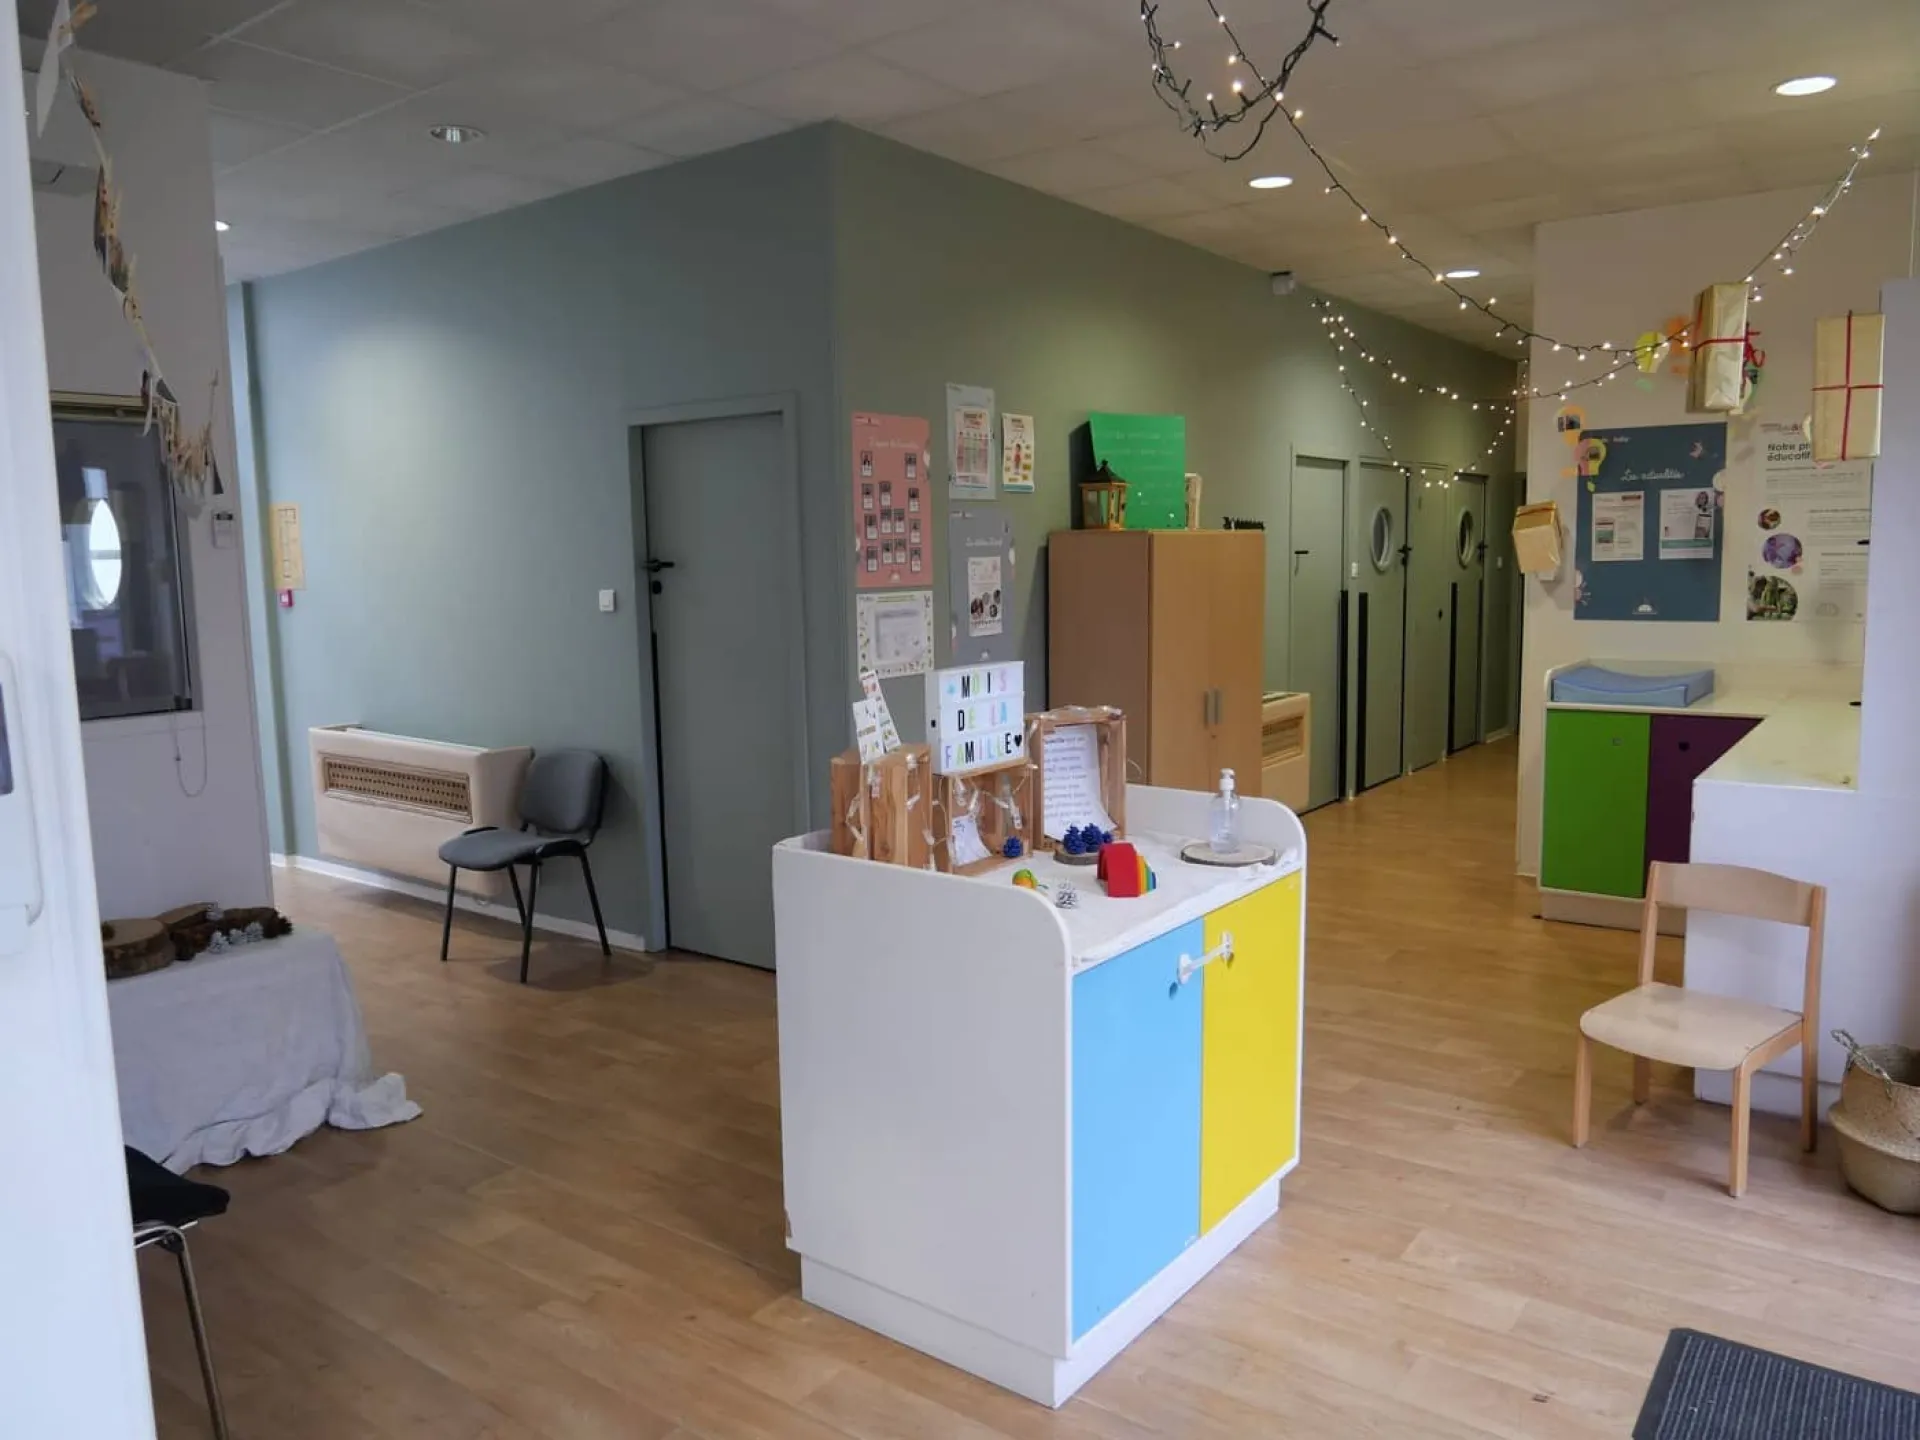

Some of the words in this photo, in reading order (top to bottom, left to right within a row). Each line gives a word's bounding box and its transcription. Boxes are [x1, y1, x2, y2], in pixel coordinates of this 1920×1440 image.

[1767, 442, 1796, 451] Notre
[1799, 443, 1811, 452] pr
[962, 667, 1008, 698] MOIS
[958, 708, 975, 731] DE
[991, 701, 1007, 725] LA
[945, 732, 1012, 768] FAMILLE
